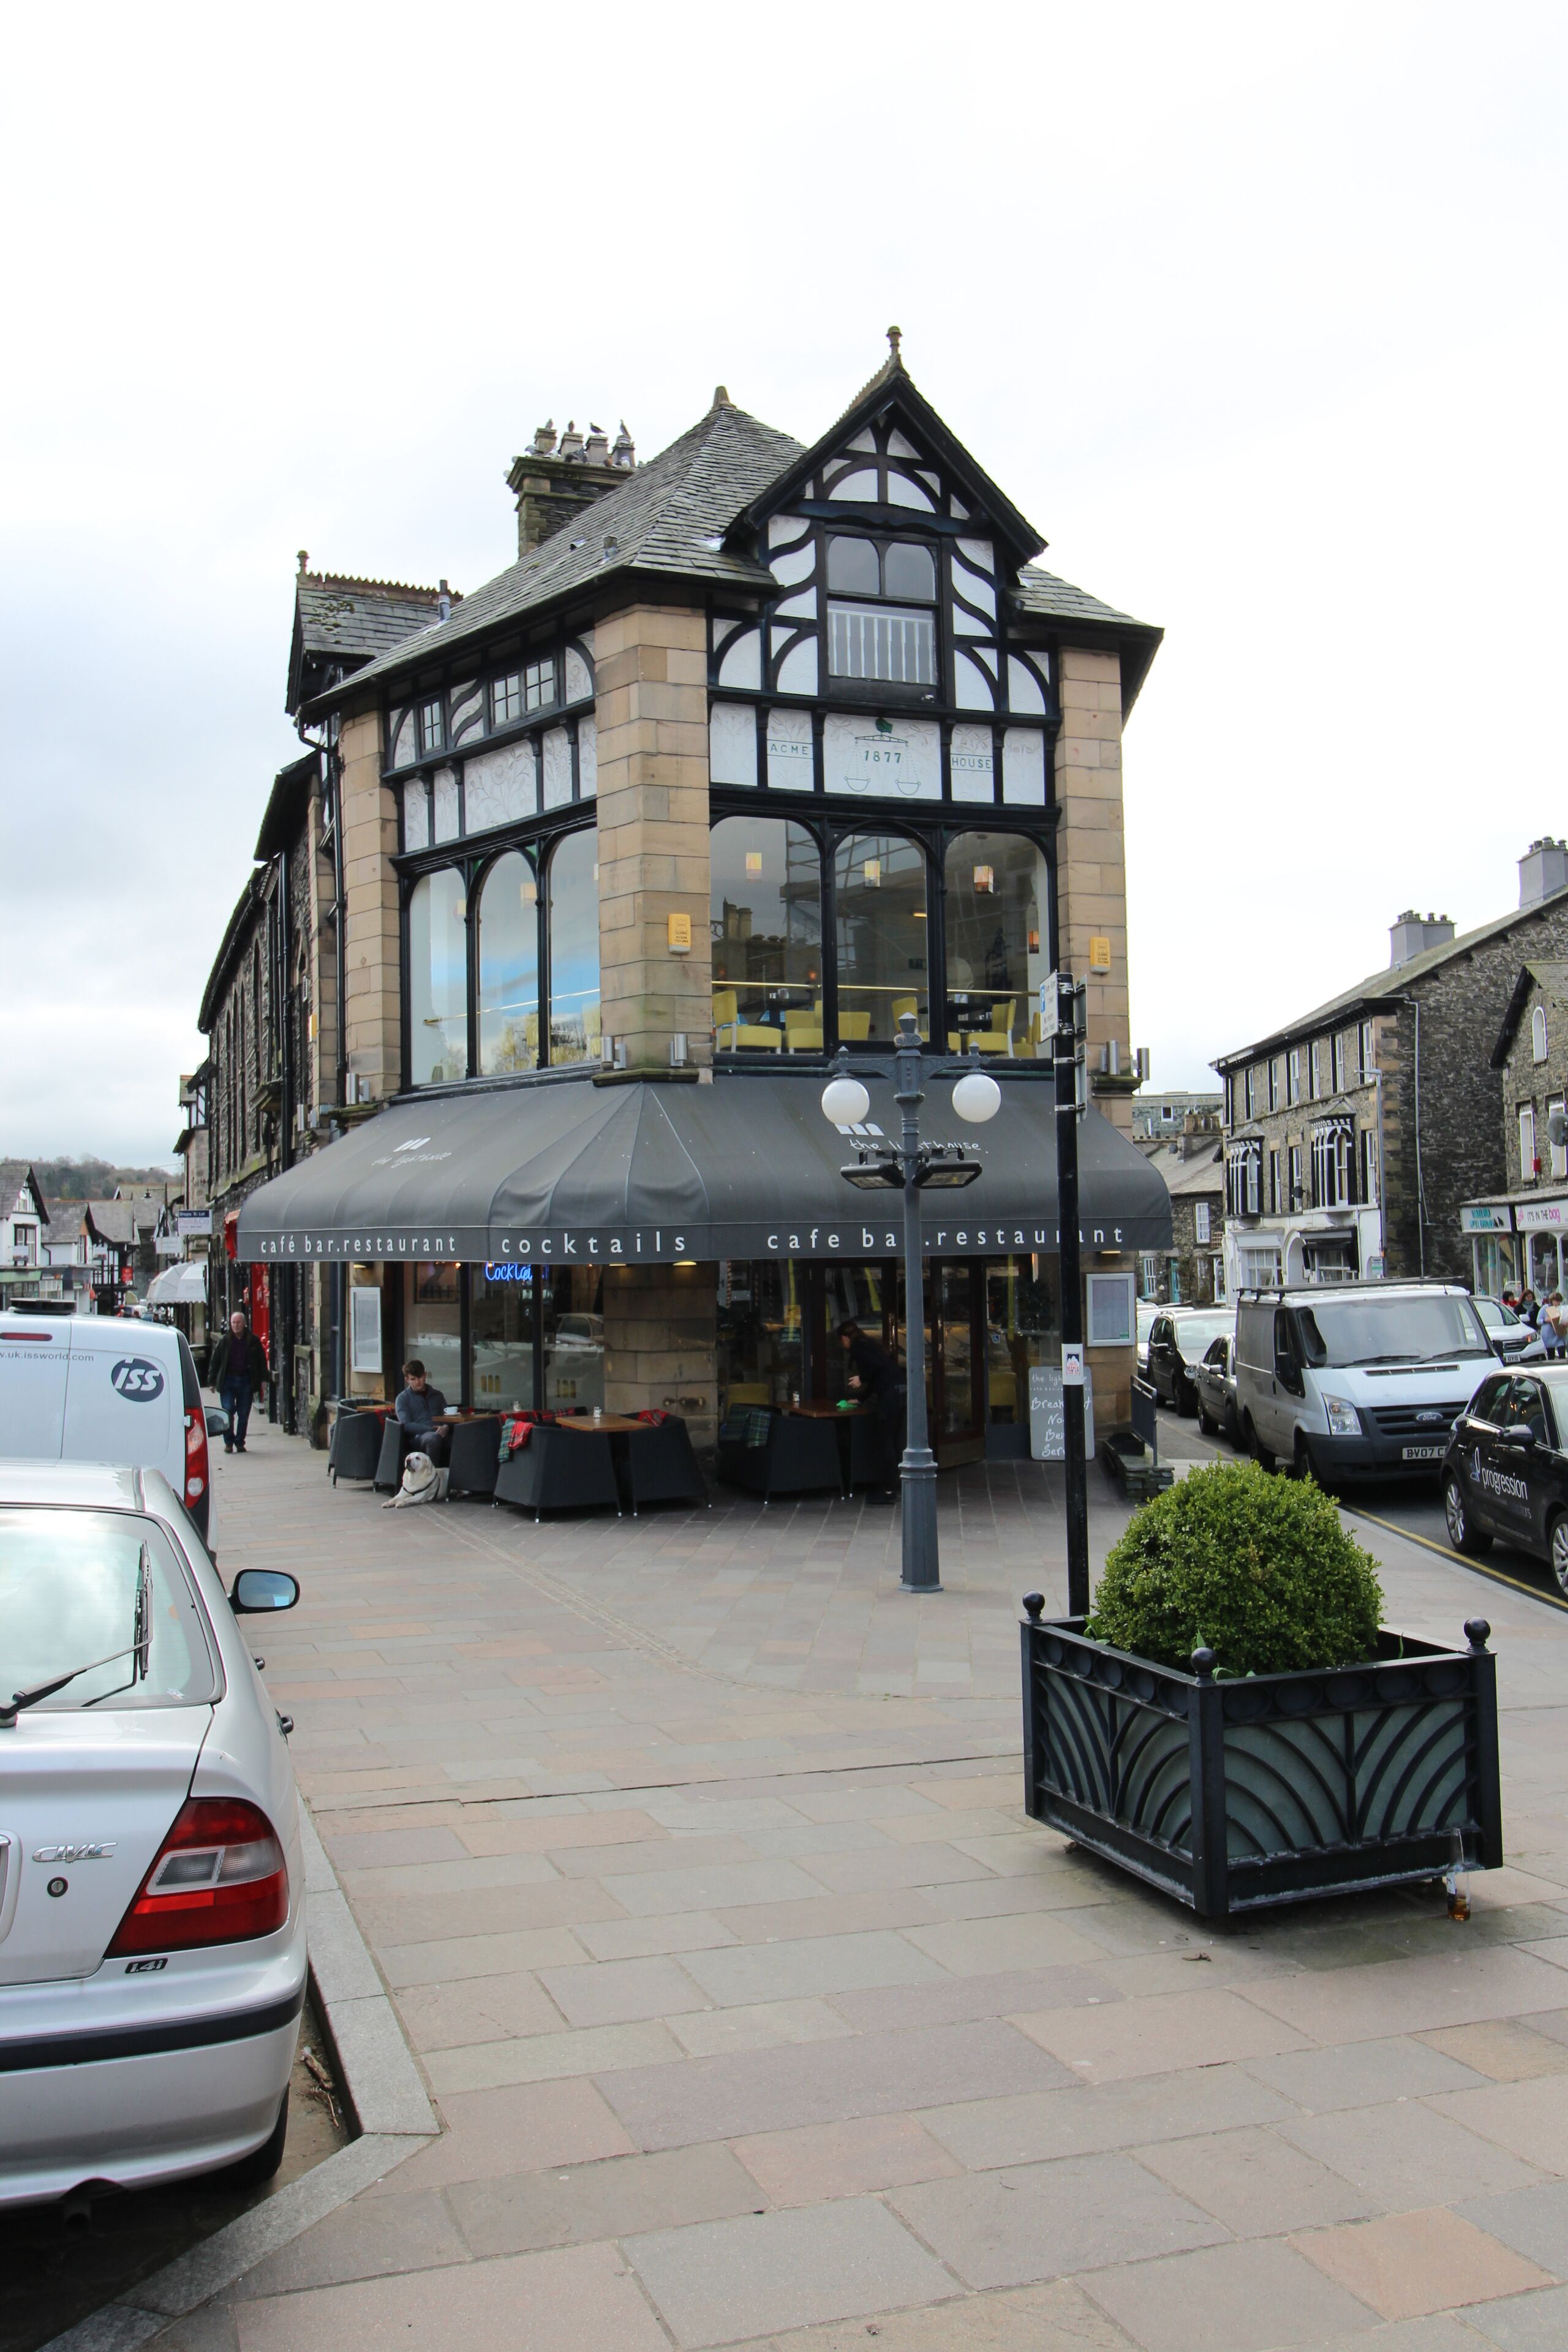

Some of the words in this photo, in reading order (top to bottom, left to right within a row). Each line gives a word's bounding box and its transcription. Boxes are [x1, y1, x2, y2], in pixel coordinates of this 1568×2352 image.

[770, 744, 809, 756] ACME
[864, 750, 902, 764] 1877
[952, 756, 992, 769] HOUSE
[849, 1139, 881, 1151] the
[260, 1235, 295, 1253] café
[501, 1231, 685, 1254] cocktails
[485, 1262, 548, 1281] Cocktai
[115, 1367, 160, 1392] ISS
[1031, 1397, 1092, 1411] Breakt
[1045, 1428, 1065, 1442] Bei
[1406, 1448, 1434, 1458] BV07
[1482, 1468, 1528, 1501] progression
[32, 1842, 118, 1863] CIVIC
[129, 1960, 165, 1973] 1.4i
